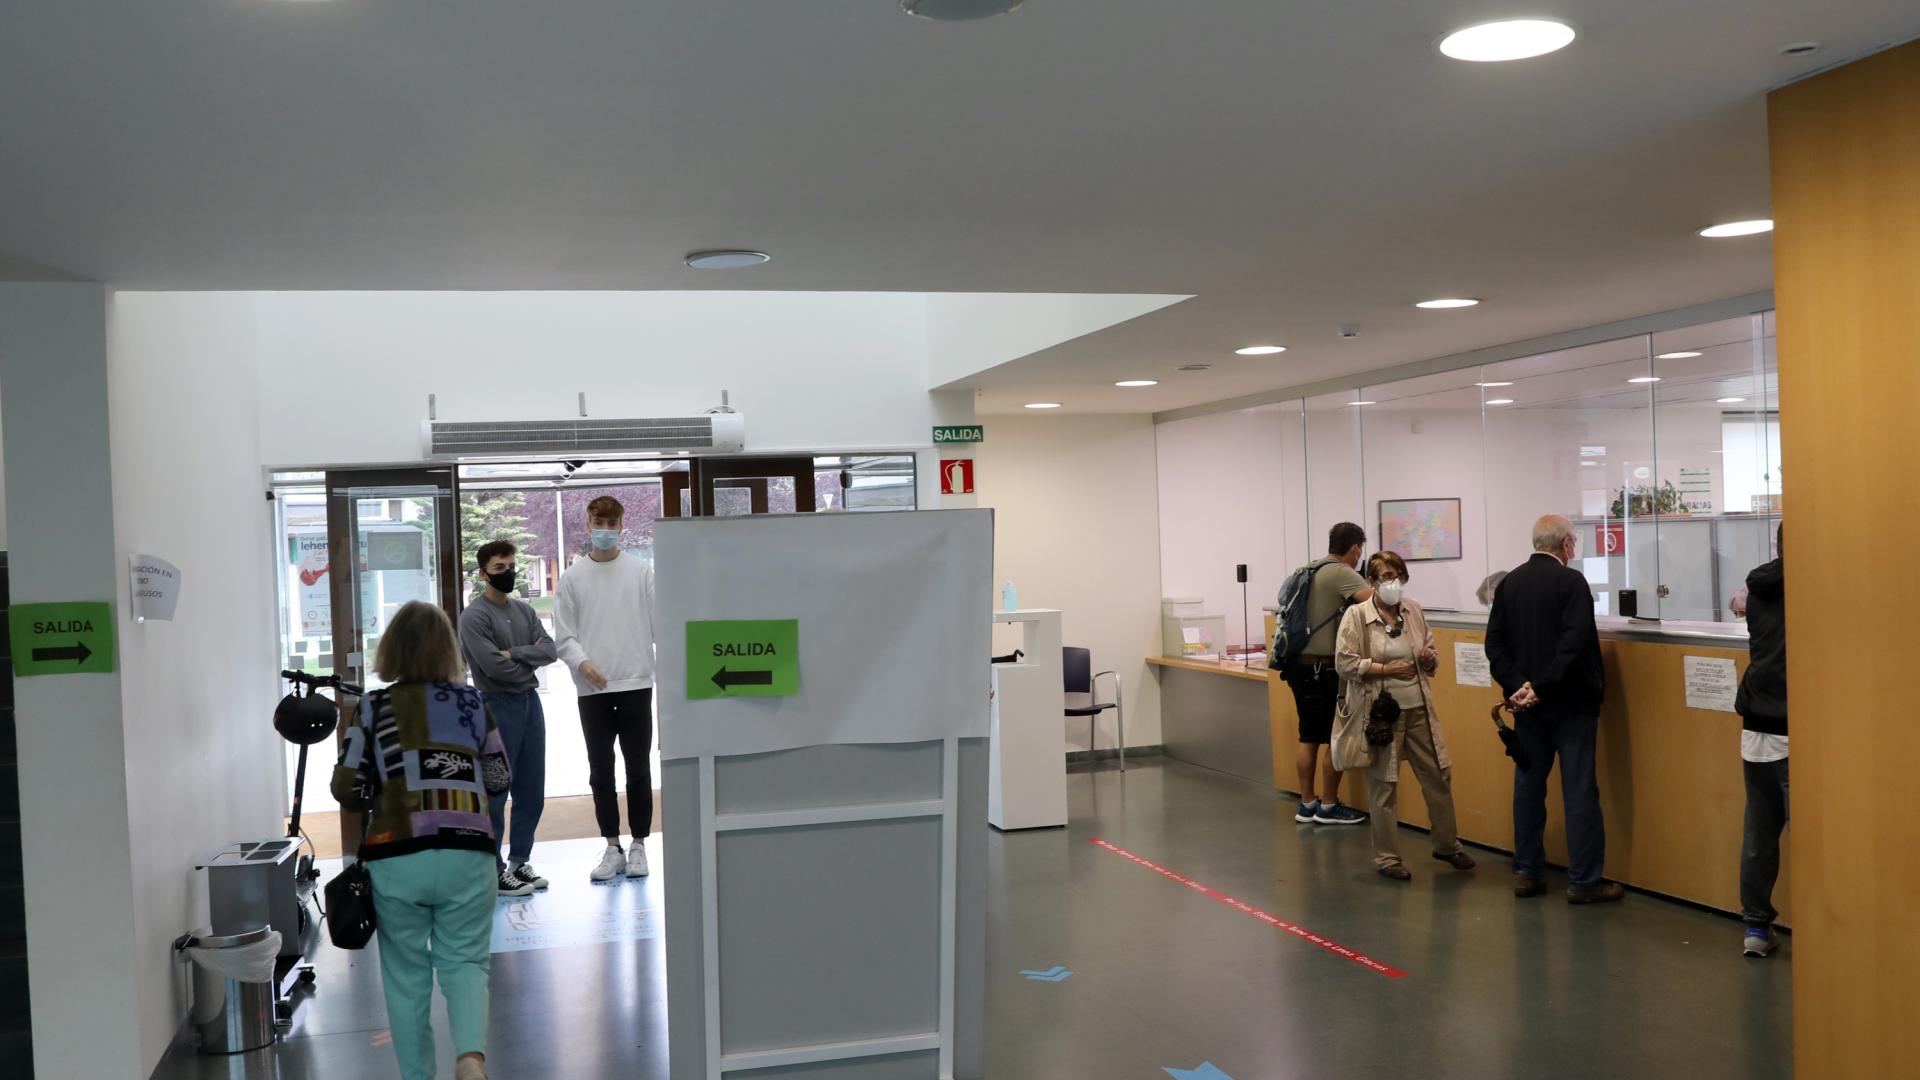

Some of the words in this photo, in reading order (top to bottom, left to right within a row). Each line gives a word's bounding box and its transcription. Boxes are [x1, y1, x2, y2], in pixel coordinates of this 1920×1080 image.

[934, 428, 982, 440] SALIDA
[33, 620, 94, 634] SALIDA
[712, 642, 776, 656] SALIDA
